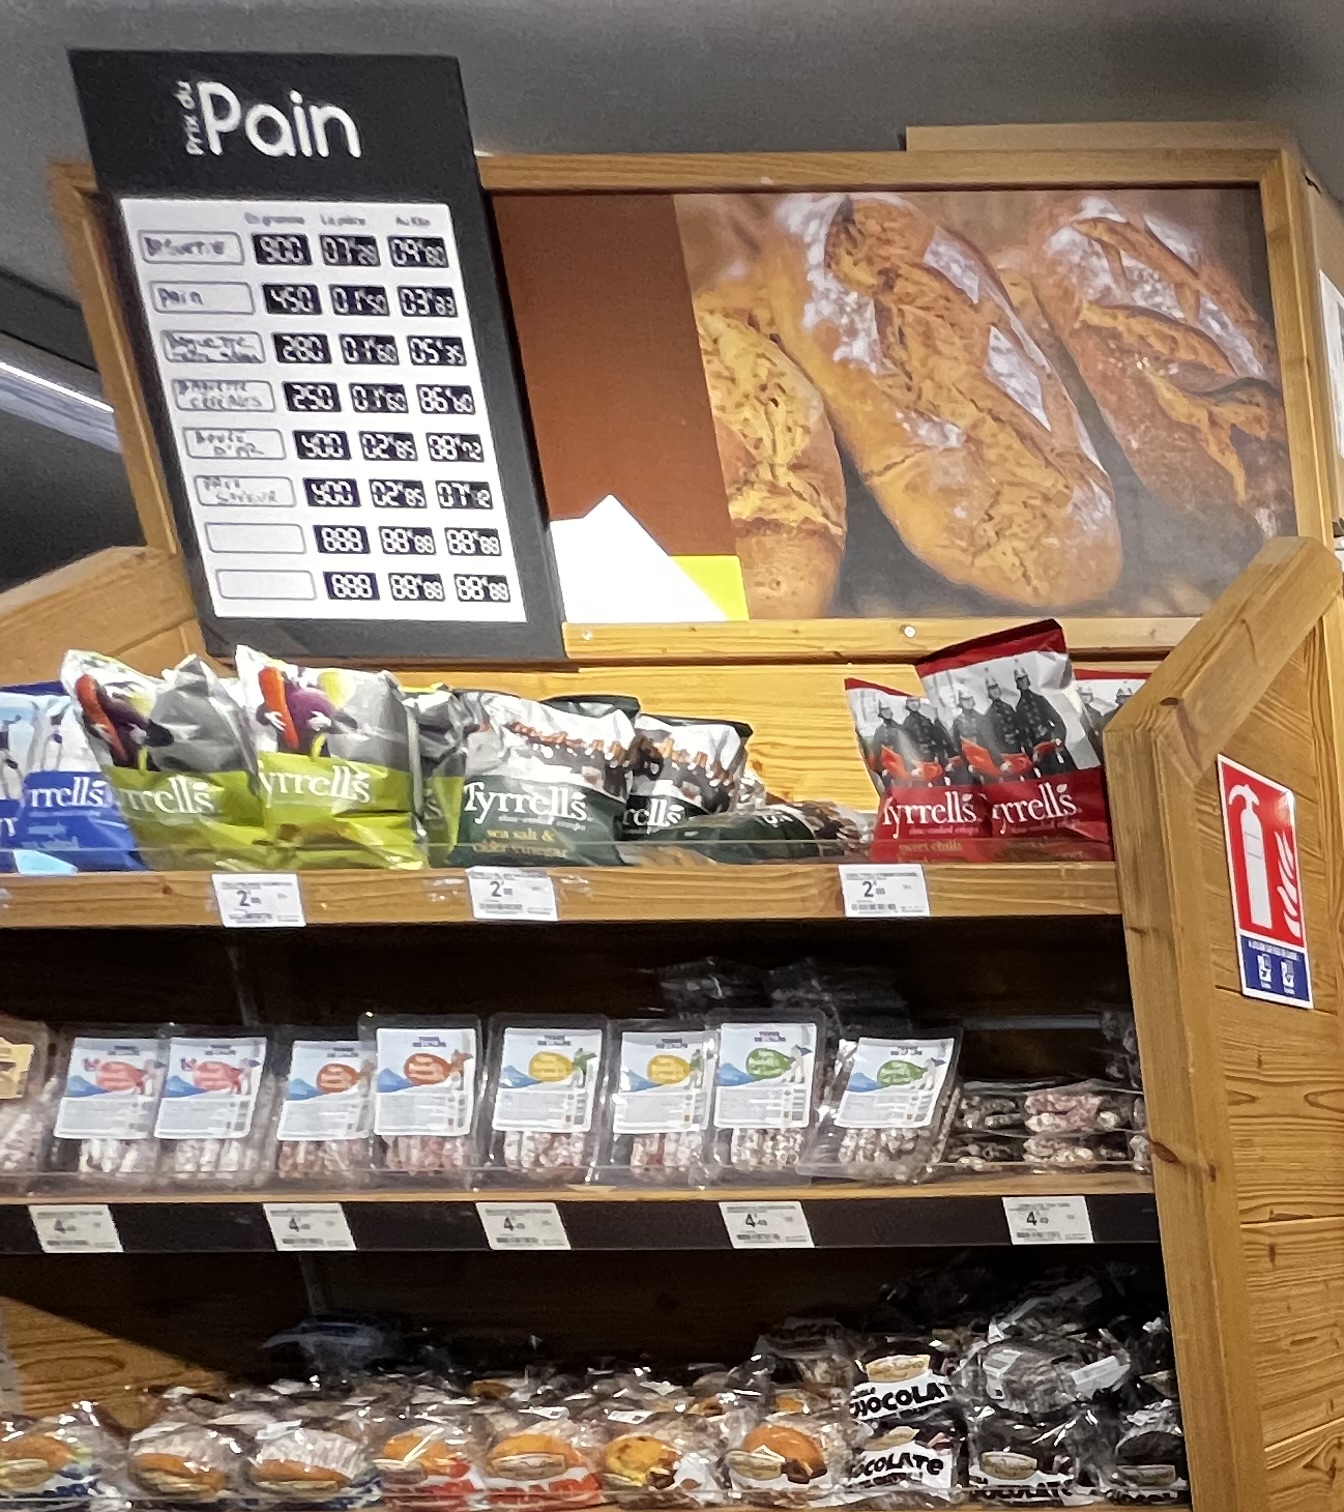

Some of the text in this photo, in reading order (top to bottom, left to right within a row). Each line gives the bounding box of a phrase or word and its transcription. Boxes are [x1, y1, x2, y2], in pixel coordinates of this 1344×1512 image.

[196, 80, 362, 158] Pain
[29, 775, 108, 808] rrells
[257, 754, 371, 810] yrrells
